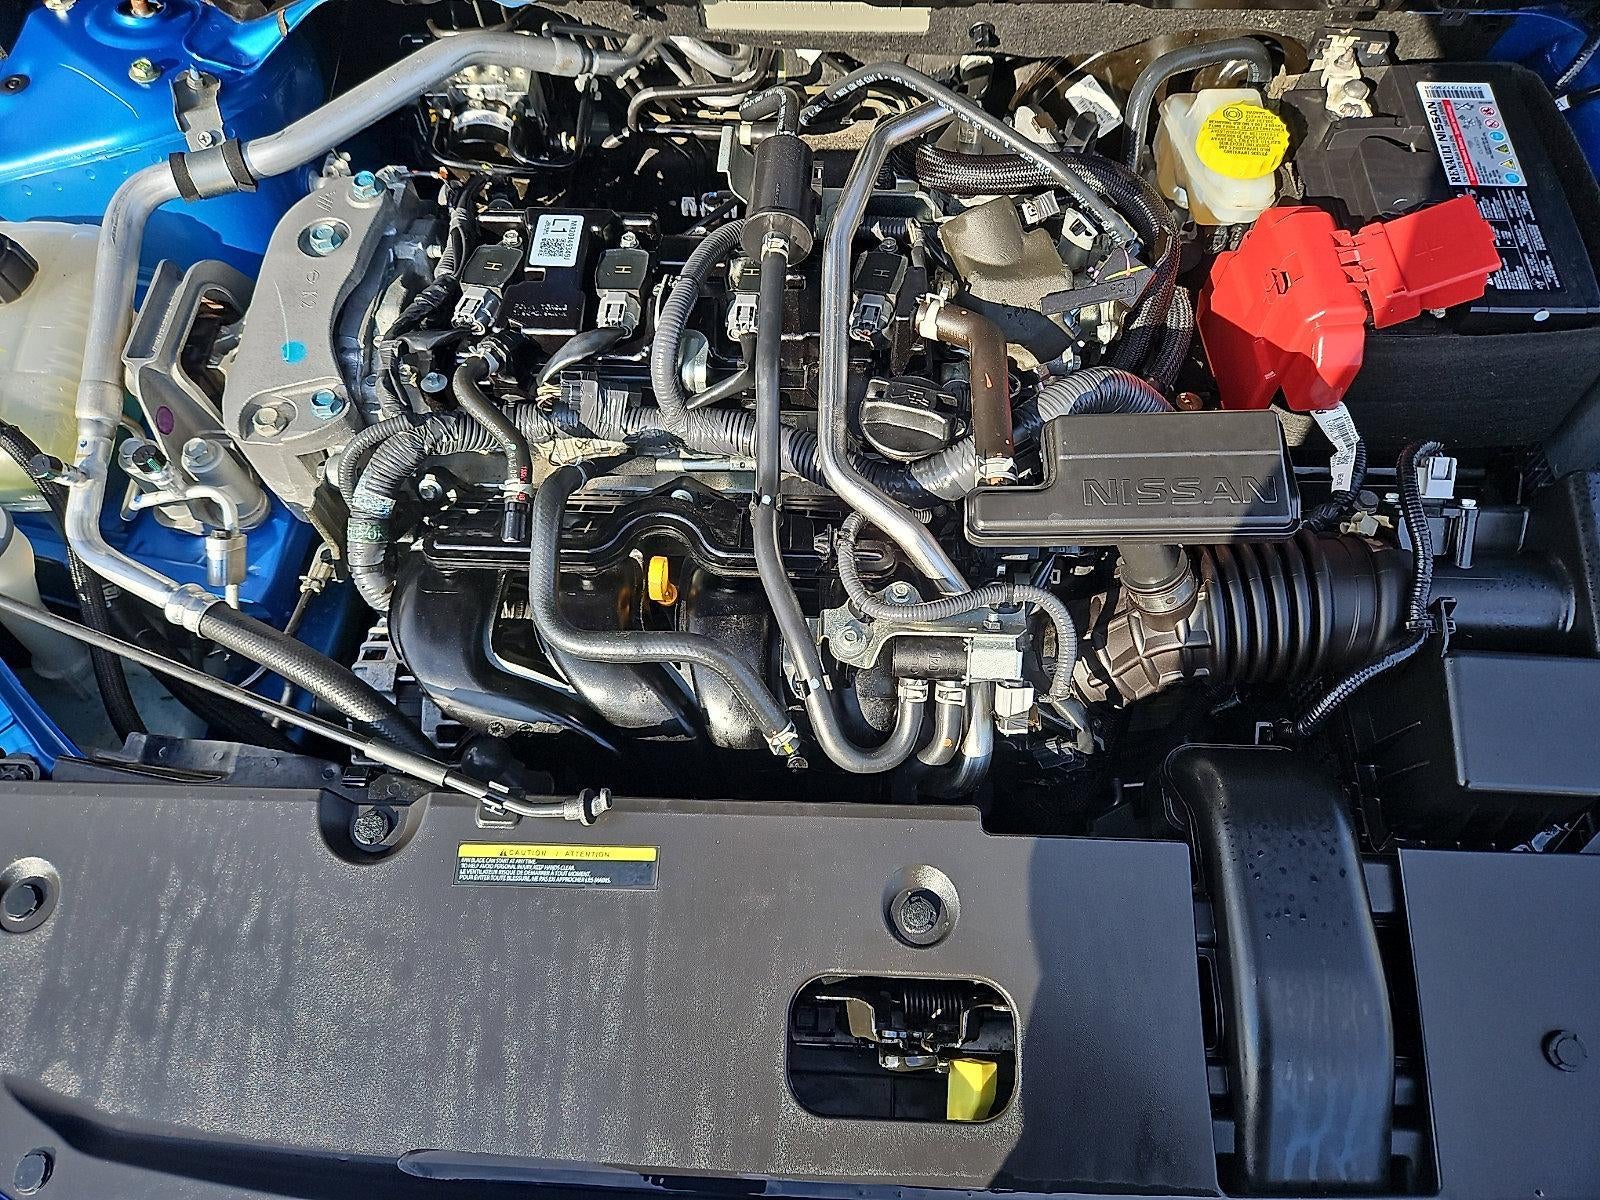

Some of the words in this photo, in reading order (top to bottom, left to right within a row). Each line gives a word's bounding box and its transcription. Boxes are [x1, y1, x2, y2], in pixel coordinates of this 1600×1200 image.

[1426, 101, 1447, 142] NISSAN
[1444, 146, 1462, 183] RENAULT
[552, 218, 570, 233] L1
[1083, 476, 1279, 507] NISSAN
[508, 849, 547, 857] CAUTION
[564, 850, 610, 858] ATTENTION
